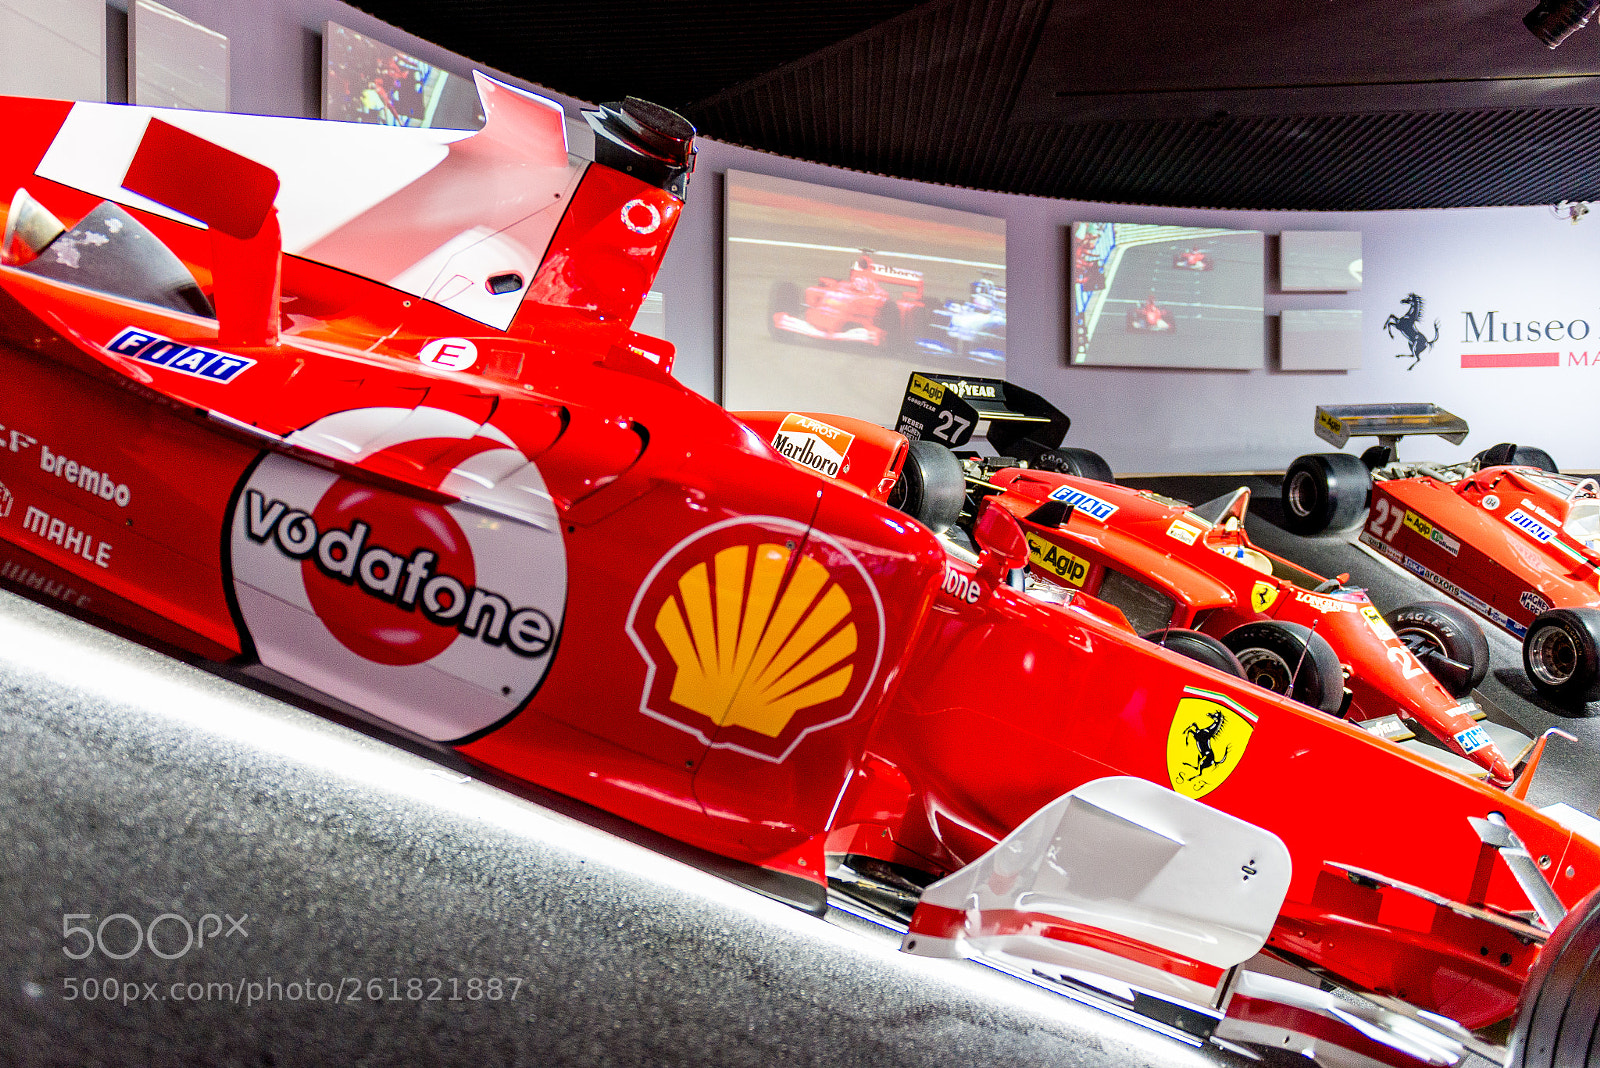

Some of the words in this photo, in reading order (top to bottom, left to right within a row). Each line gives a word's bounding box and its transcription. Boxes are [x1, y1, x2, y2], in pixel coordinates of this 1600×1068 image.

[872, 264, 921, 279] rlboro
[1460, 310, 1590, 343] Museo
[115, 333, 243, 377] FIAT
[431, 343, 467, 367] E
[922, 383, 943, 400] Agip
[902, 415, 924, 430] WEBER
[932, 410, 971, 444] 27
[773, 433, 839, 476] Marlboro
[40, 444, 131, 507] brembo
[1052, 487, 1115, 519] FIAT
[1369, 497, 1405, 543] 27
[22, 505, 113, 569] MAHLE
[1413, 517, 1431, 536] Agip
[245, 488, 557, 659] vodafone
[1042, 544, 1085, 581] Agip
[1424, 569, 1461, 597] arexons
[1387, 645, 1426, 681] 2
